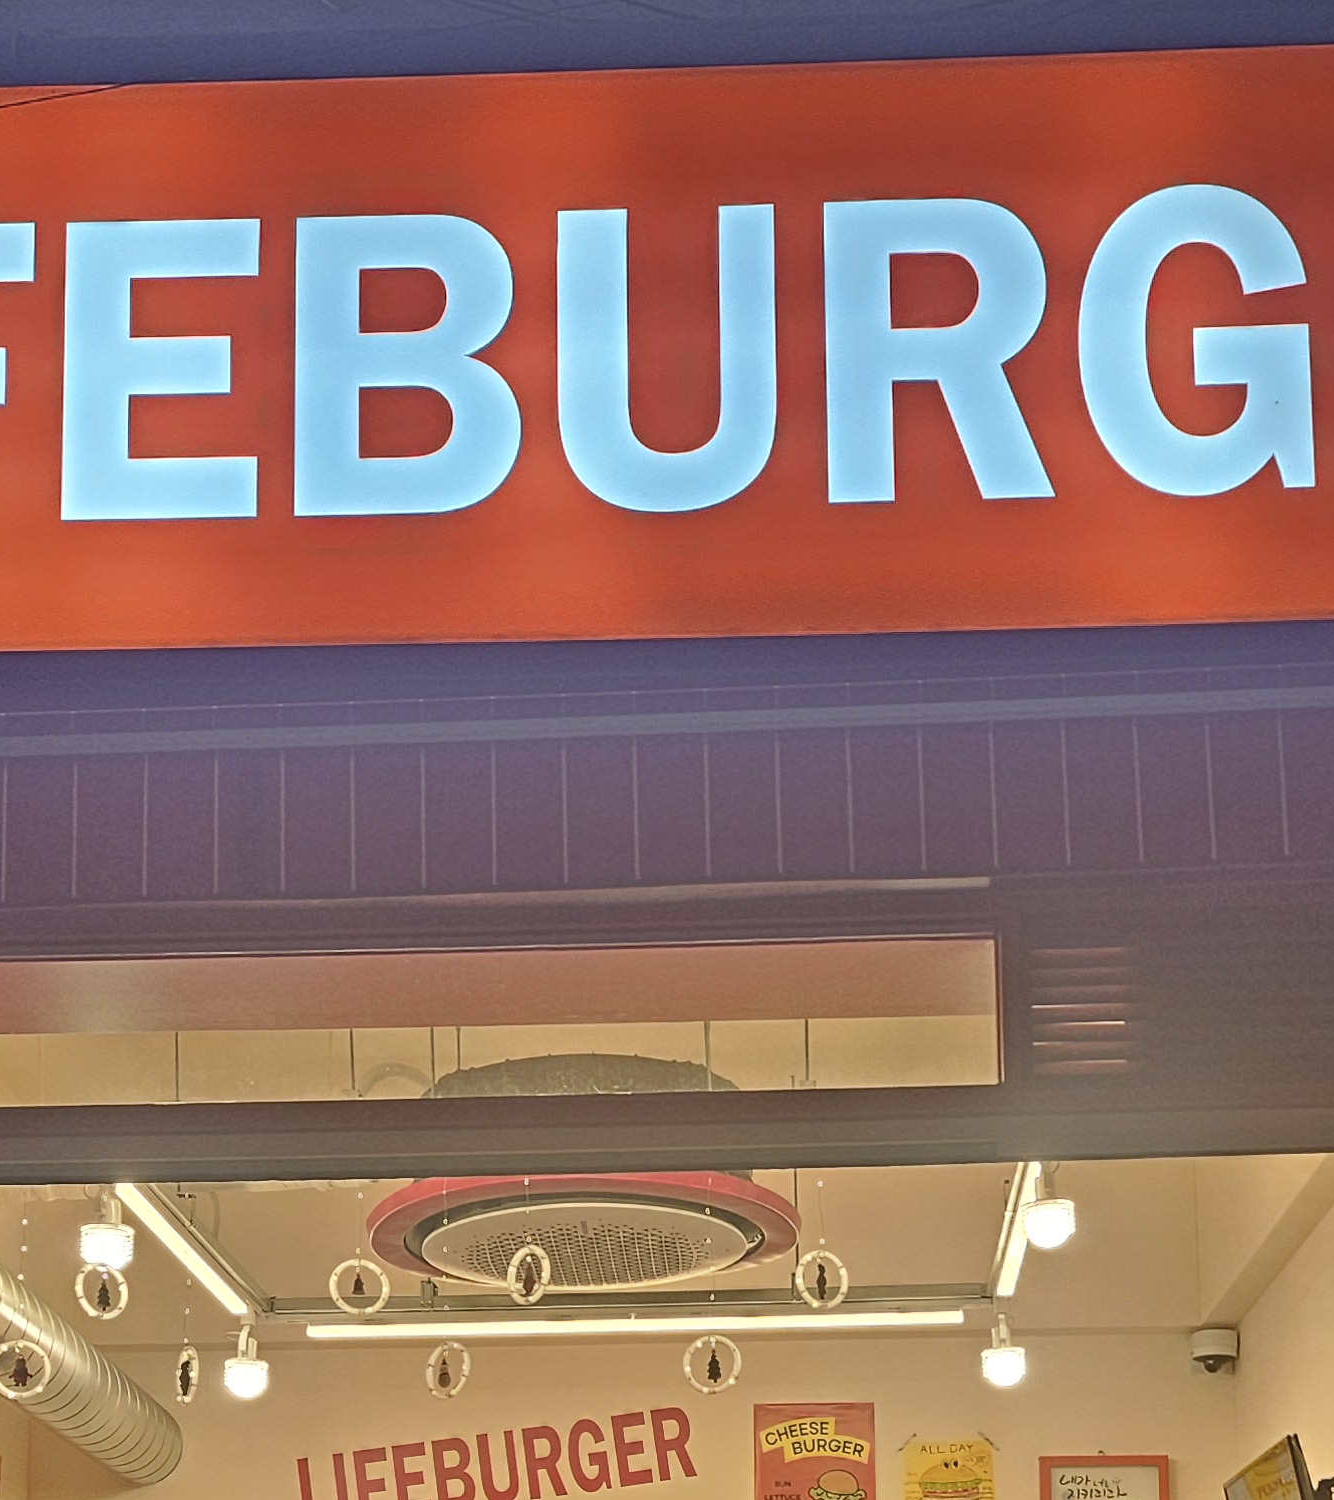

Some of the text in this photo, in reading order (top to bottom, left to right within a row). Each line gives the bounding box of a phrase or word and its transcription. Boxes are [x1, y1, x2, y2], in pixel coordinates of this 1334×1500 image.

[764, 1421, 830, 1446] CHEESE
[792, 1438, 865, 1458] BURGER
[920, 1443, 973, 1454] ALL DAY
